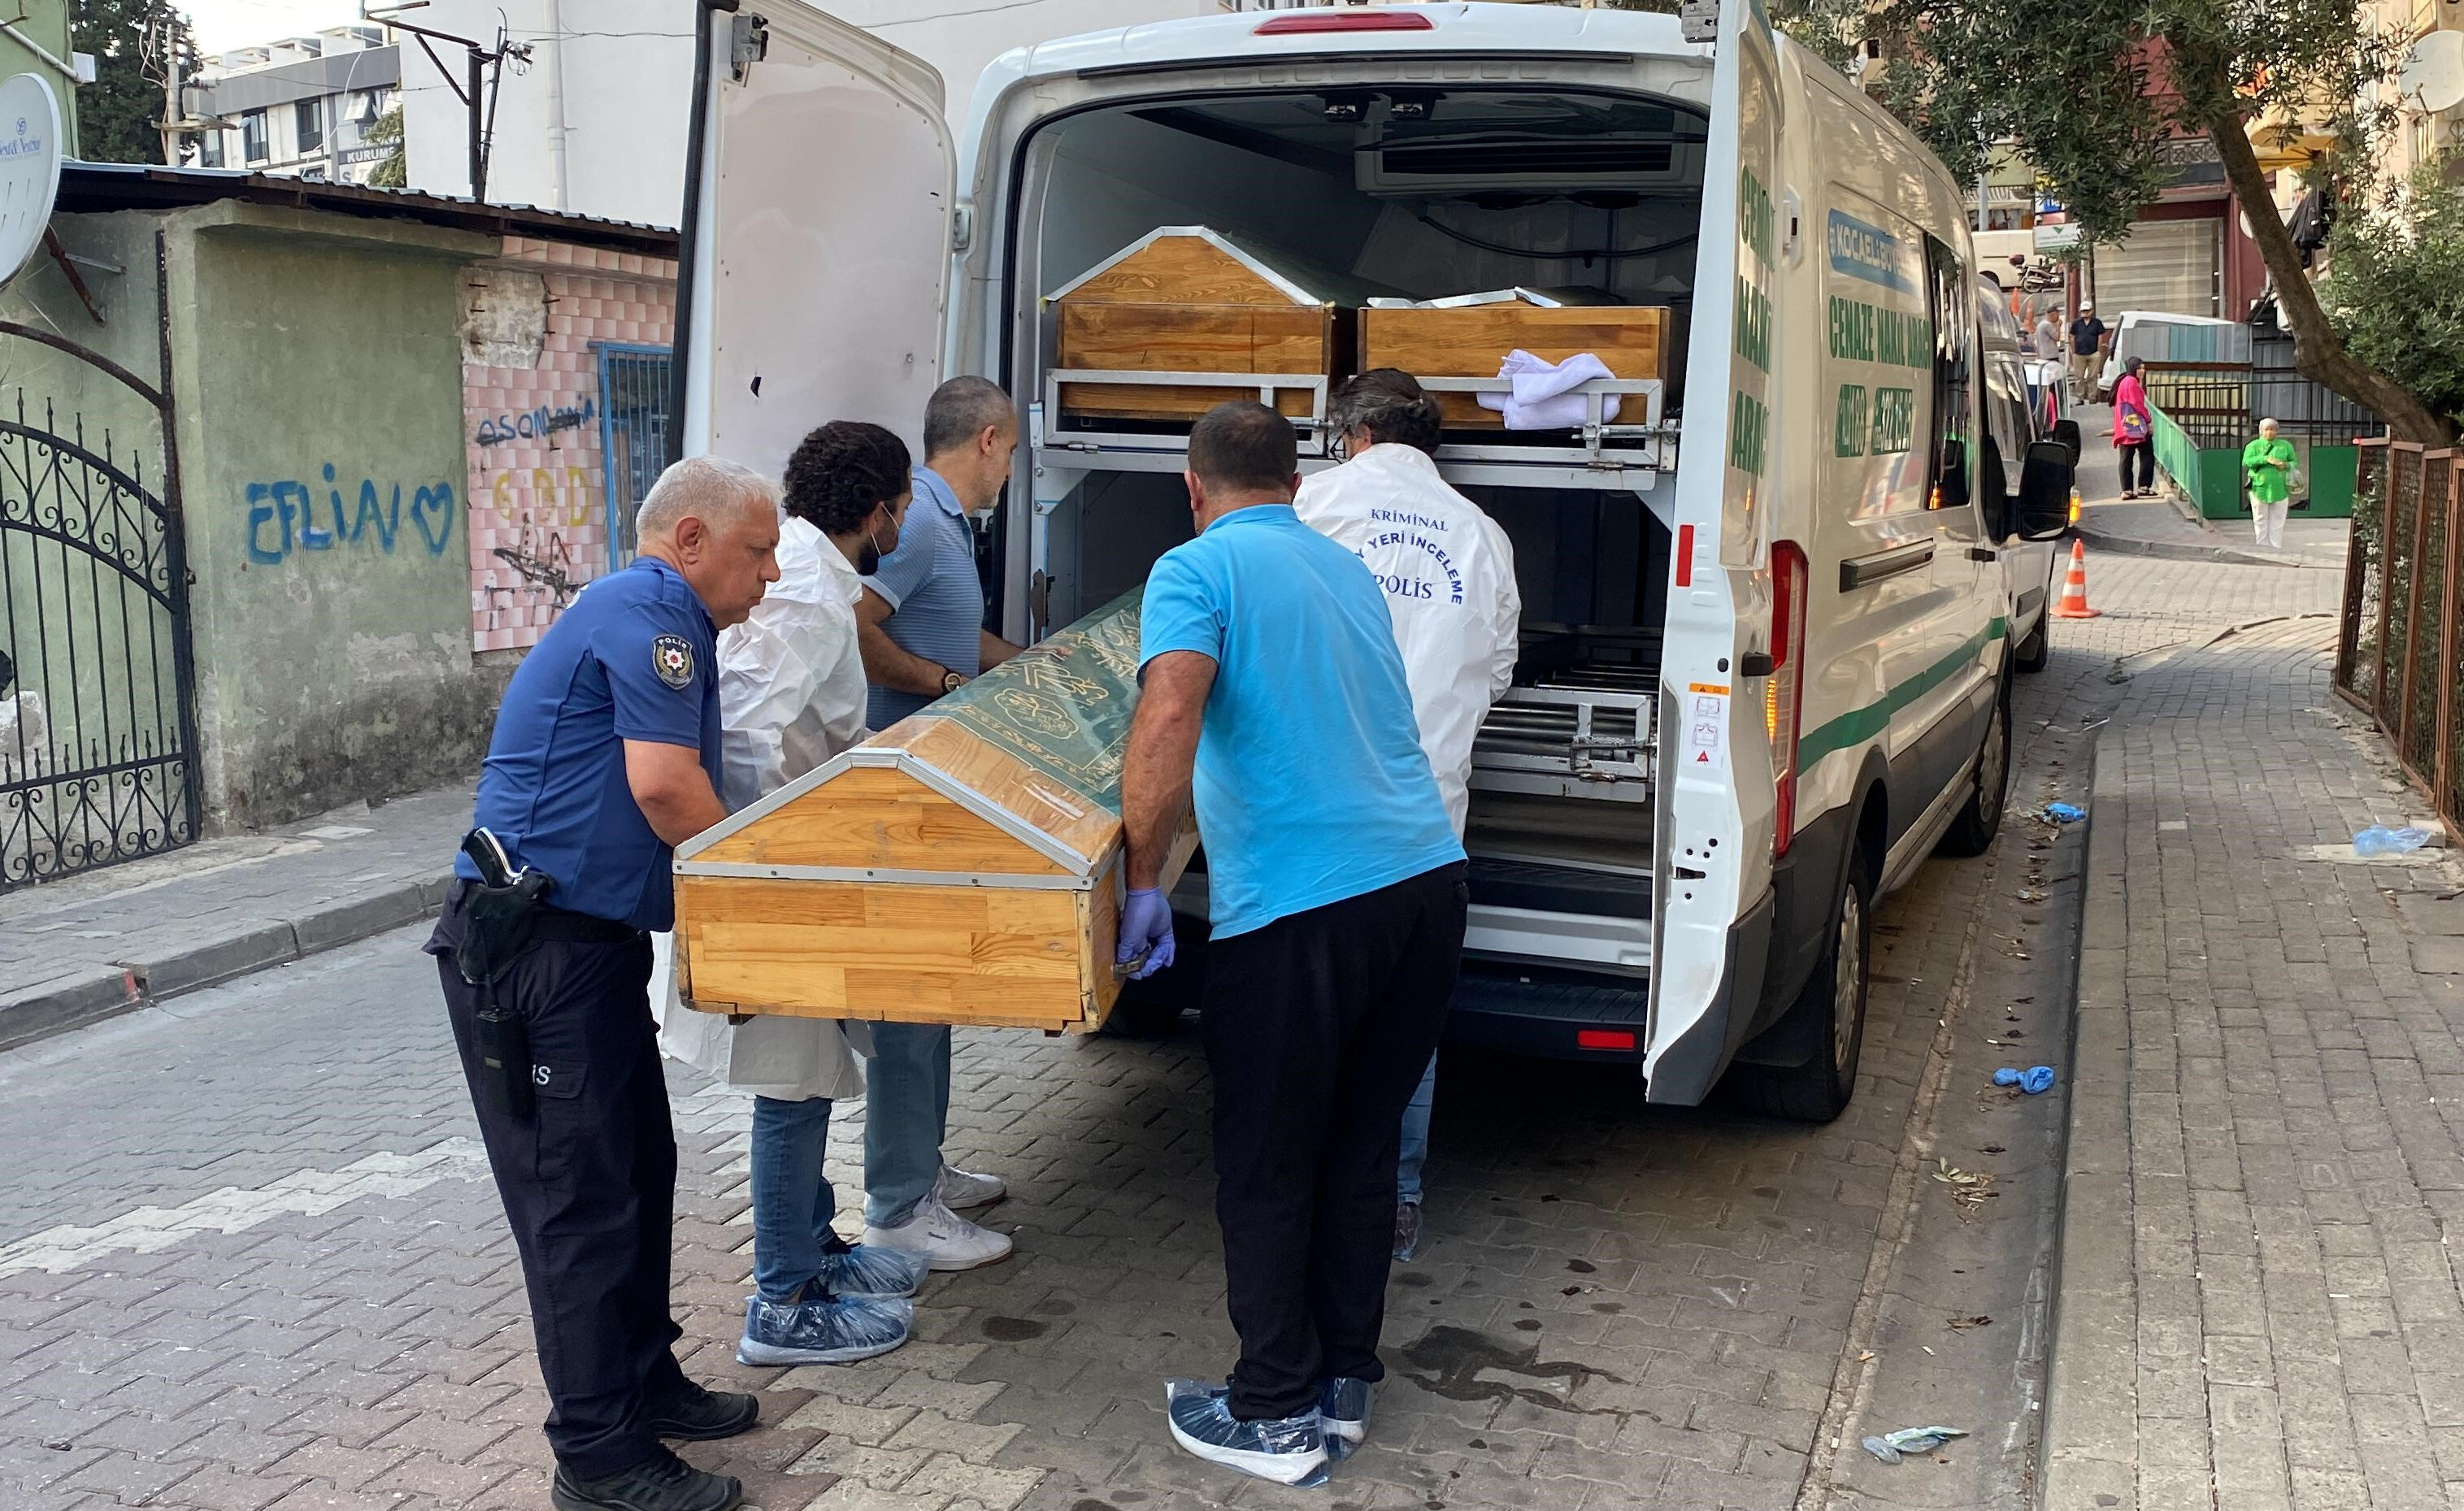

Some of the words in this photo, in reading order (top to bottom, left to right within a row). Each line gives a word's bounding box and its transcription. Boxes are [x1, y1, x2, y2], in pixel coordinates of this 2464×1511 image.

[1829, 294, 1873, 362] CENAZE
[1371, 508, 1449, 532] KRİMİNAL
[1367, 531, 1405, 550] YERİ
[1410, 533, 1462, 606] İNCELEME
[1374, 575, 1432, 600] POLİS
